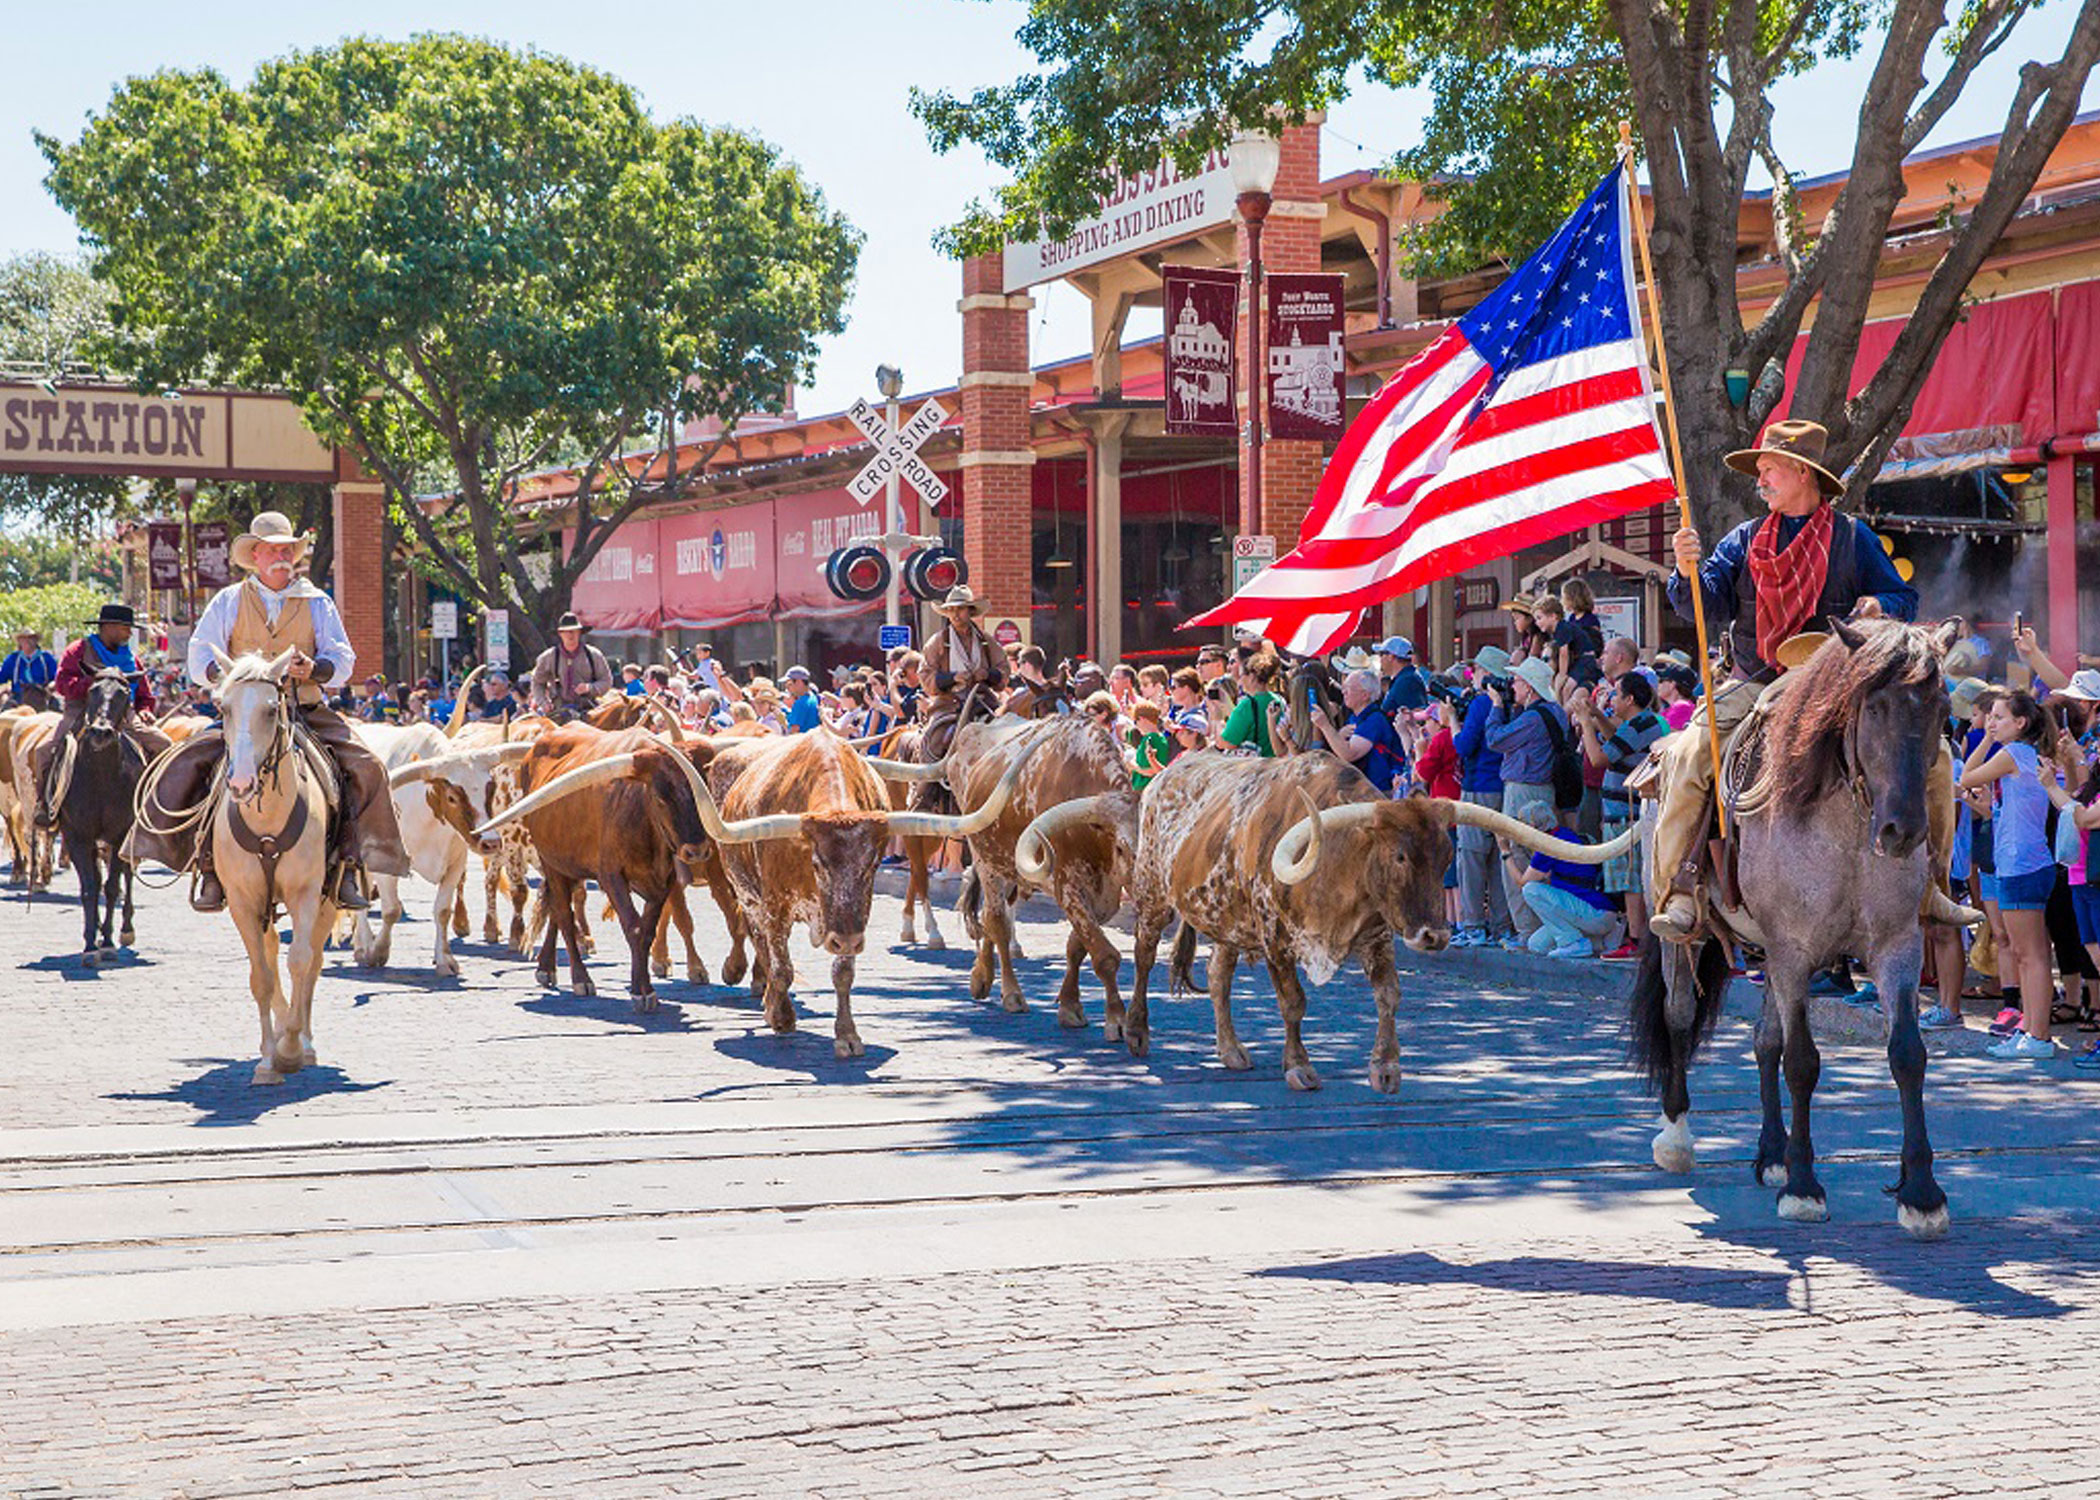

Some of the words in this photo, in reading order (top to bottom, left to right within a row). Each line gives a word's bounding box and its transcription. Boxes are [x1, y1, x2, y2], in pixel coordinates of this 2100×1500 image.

[1040, 222, 1109, 268] SHOPPING
[1112, 211, 1142, 244] AND
[1146, 189, 1205, 232] DINING
[1277, 303, 1335, 315] STOCKYARDS
[5, 397, 206, 457] STATION
[855, 406, 941, 497] CROSSING
